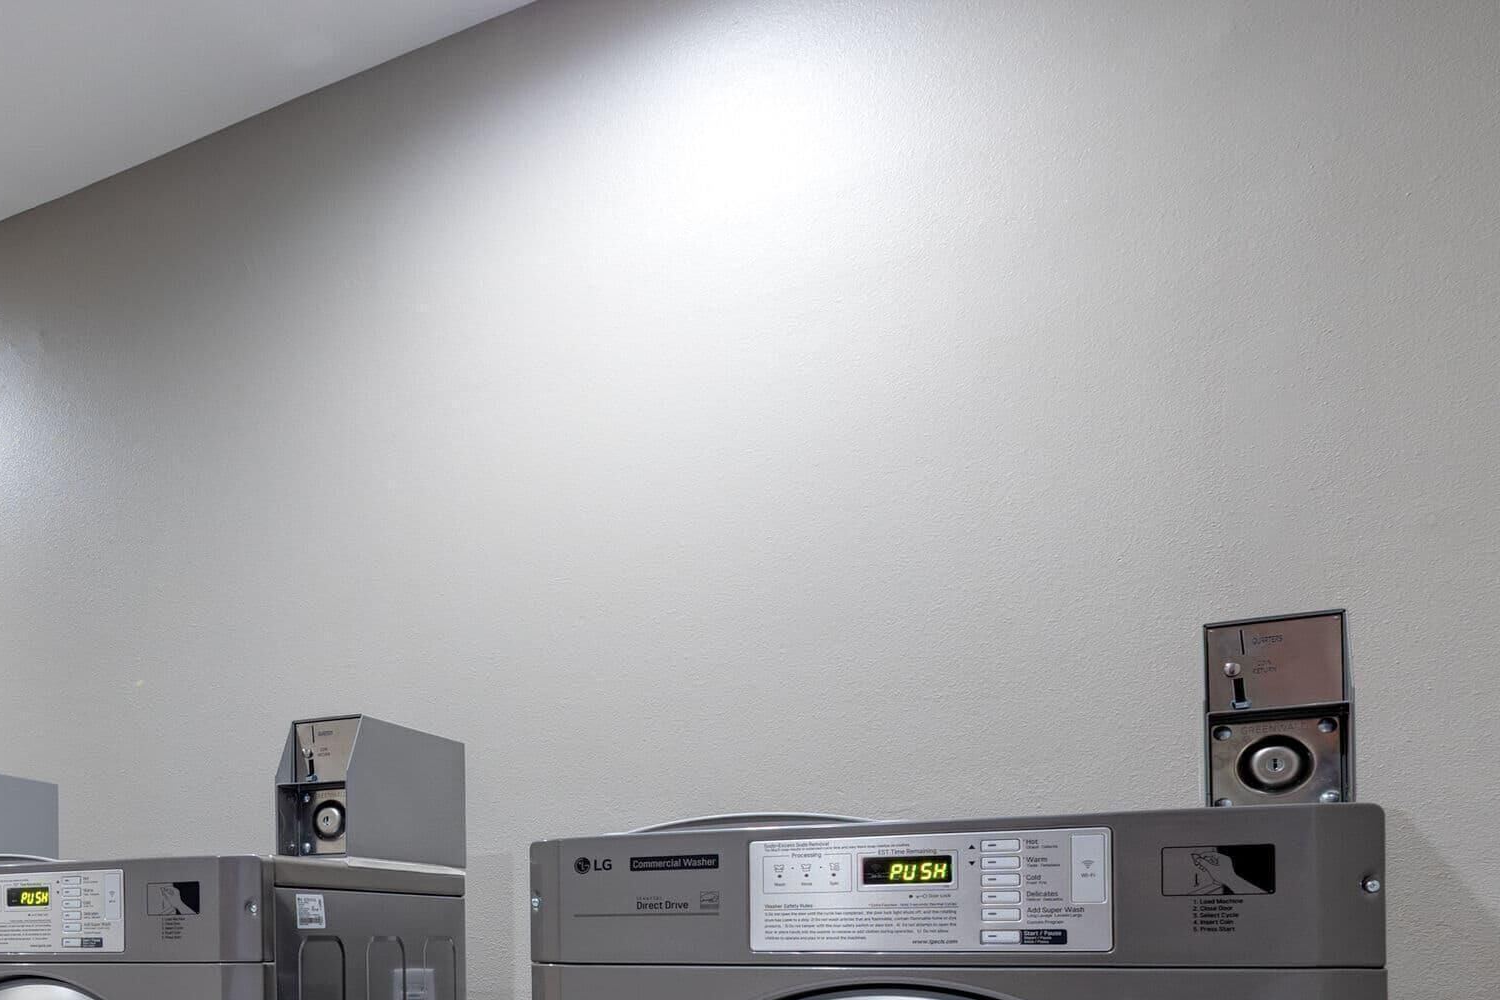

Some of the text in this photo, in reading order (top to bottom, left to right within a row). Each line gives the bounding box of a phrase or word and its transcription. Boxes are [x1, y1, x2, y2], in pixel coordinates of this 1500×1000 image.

[593, 858, 717, 871] LG Commercial Washer
[889, 863, 947, 880] PUSH
[20, 892, 49, 904] PUSH
[636, 901, 689, 910] Direct Drive
